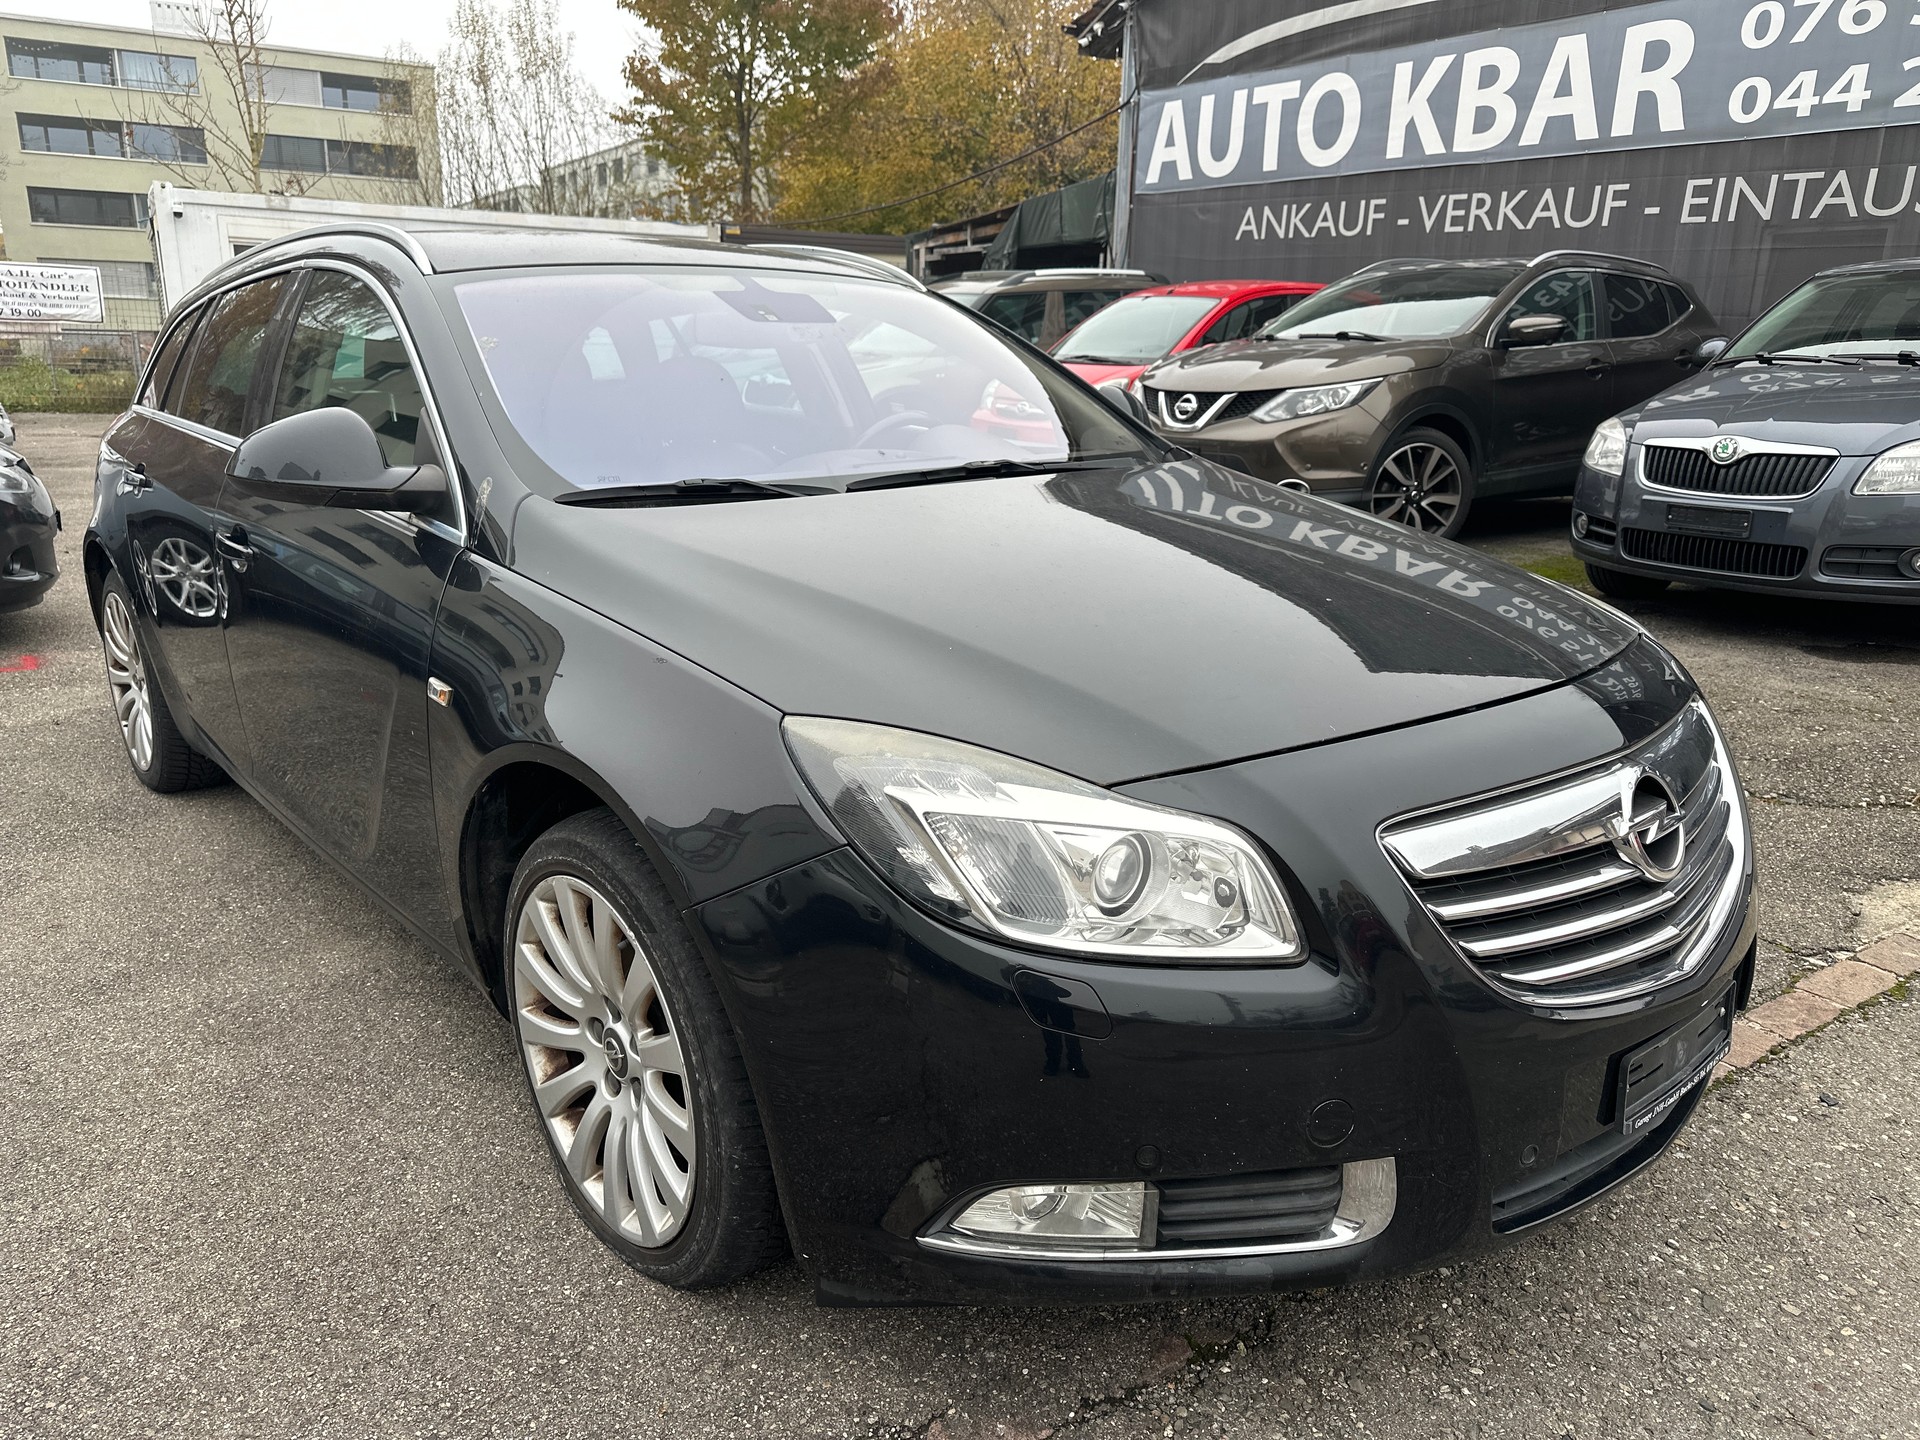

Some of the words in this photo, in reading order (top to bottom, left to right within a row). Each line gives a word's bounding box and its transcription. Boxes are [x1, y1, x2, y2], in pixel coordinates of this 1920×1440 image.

[1740, 0, 1888, 49] 076
[1145, 72, 1362, 185] AUTO
[1386, 19, 1696, 160] KBAR
[1728, 62, 1872, 124] 044
[1235, 198, 1387, 241] ANKAUF
[1418, 183, 1631, 233] VERKAUF
[1680, 165, 1920, 224] EINTAU
[10, 307, 22, 317] 19
[27, 308, 42, 318] 00
[41, 293, 80, 301] Verkauf
